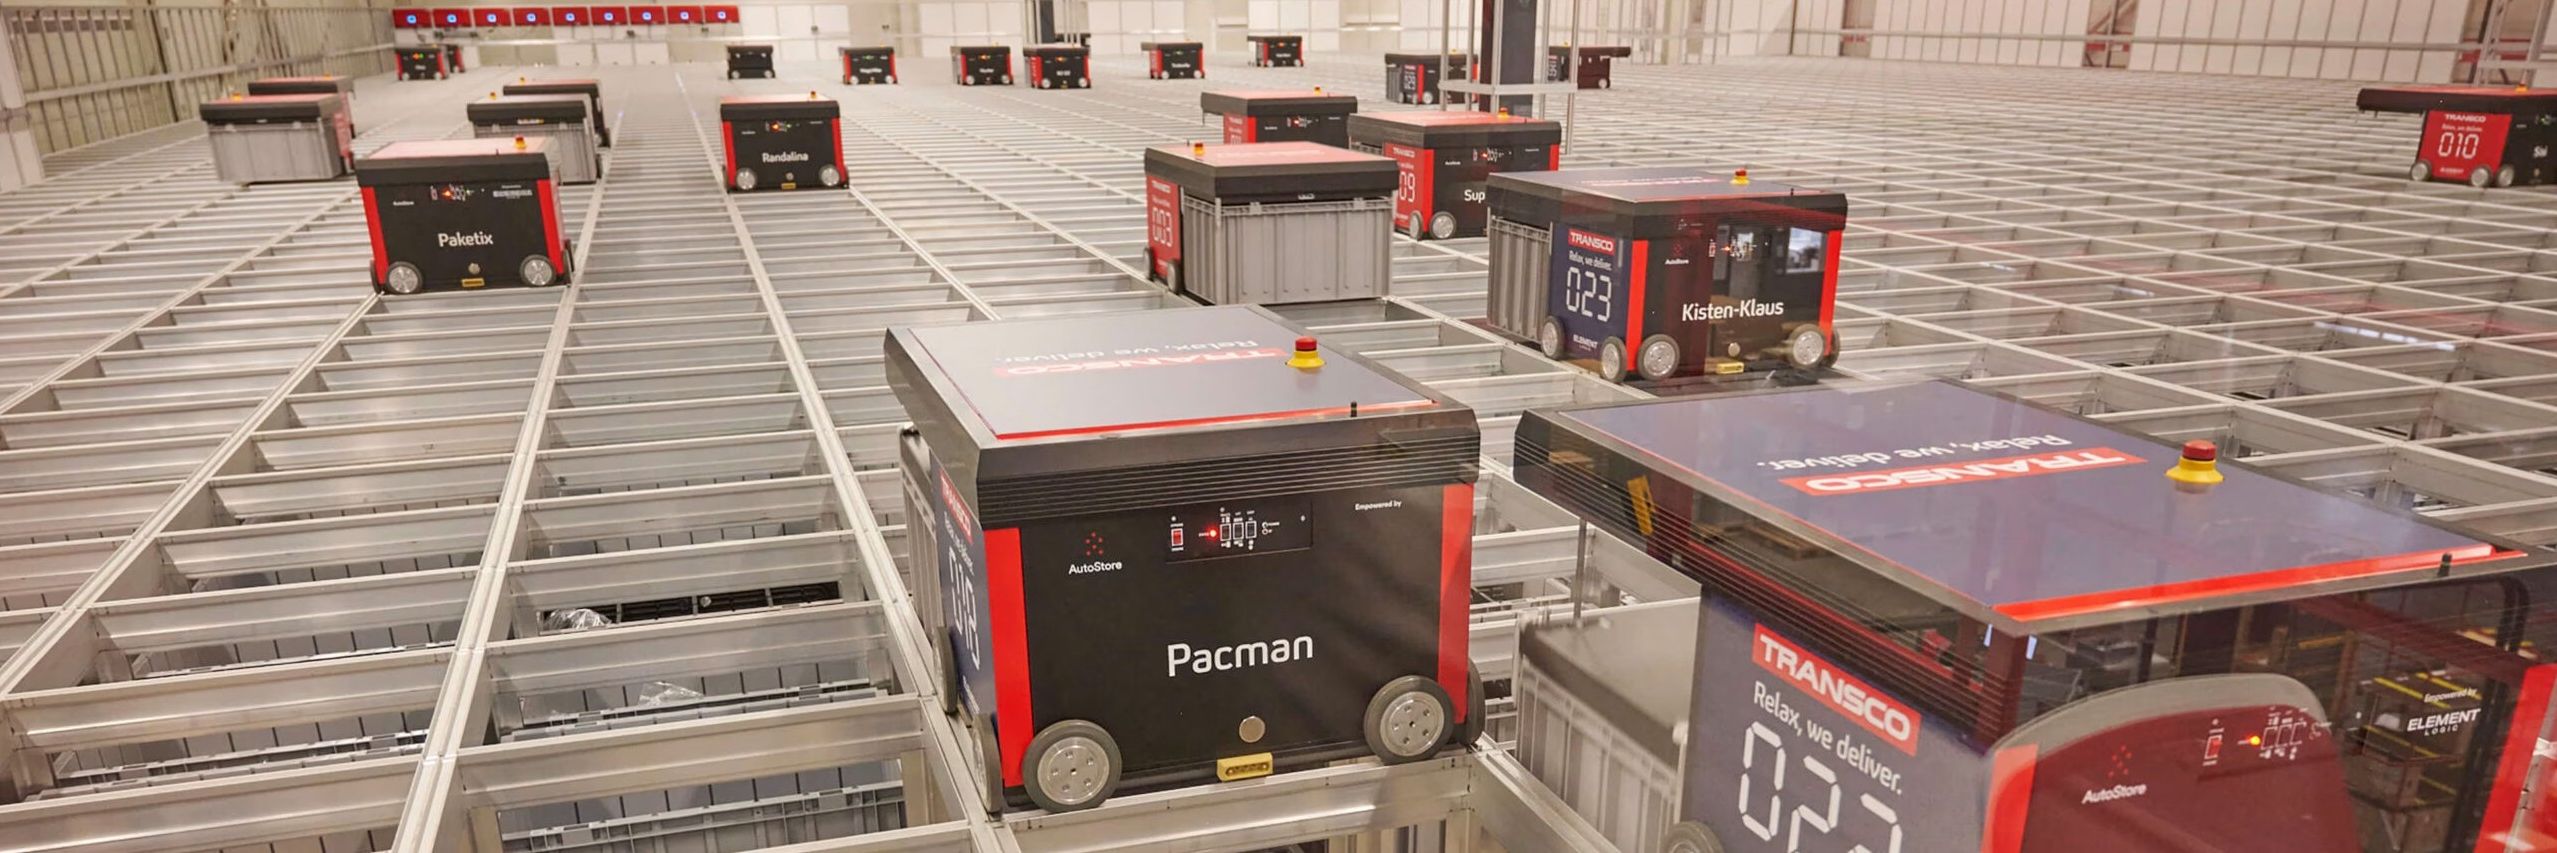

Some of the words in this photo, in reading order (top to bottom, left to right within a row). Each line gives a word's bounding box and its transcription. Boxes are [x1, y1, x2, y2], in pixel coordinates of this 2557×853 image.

[761, 151, 809, 163] Randalina
[2438, 132, 2479, 159] 010
[1399, 171, 1416, 203] 09
[1464, 188, 1486, 203] Sup
[1152, 206, 1173, 247] 003
[437, 231, 494, 247] Paketix
[1570, 231, 1614, 252] TRANSCO
[1566, 266, 1612, 323] 023
[1682, 298, 1784, 322] Kisten-Klaus
[1007, 351, 1278, 375] TRANSCO
[1894, 446, 1946, 459] we
[1950, 434, 2072, 452] Relax,
[1757, 452, 1892, 471] deliver.
[1806, 452, 2126, 491] TRANSCO
[1068, 560, 1122, 575] AutoStore
[1167, 635, 1313, 677] Pacman
[1759, 634, 1911, 741] TRANSCO
[2407, 708, 2482, 731] ELEMENT
[2424, 724, 2459, 736] LOGIC
[1754, 681, 1802, 737] Relax,
[1807, 719, 1834, 750] we
[1836, 735, 1902, 795] deliver.
[2081, 783, 2147, 805] AutoStore
